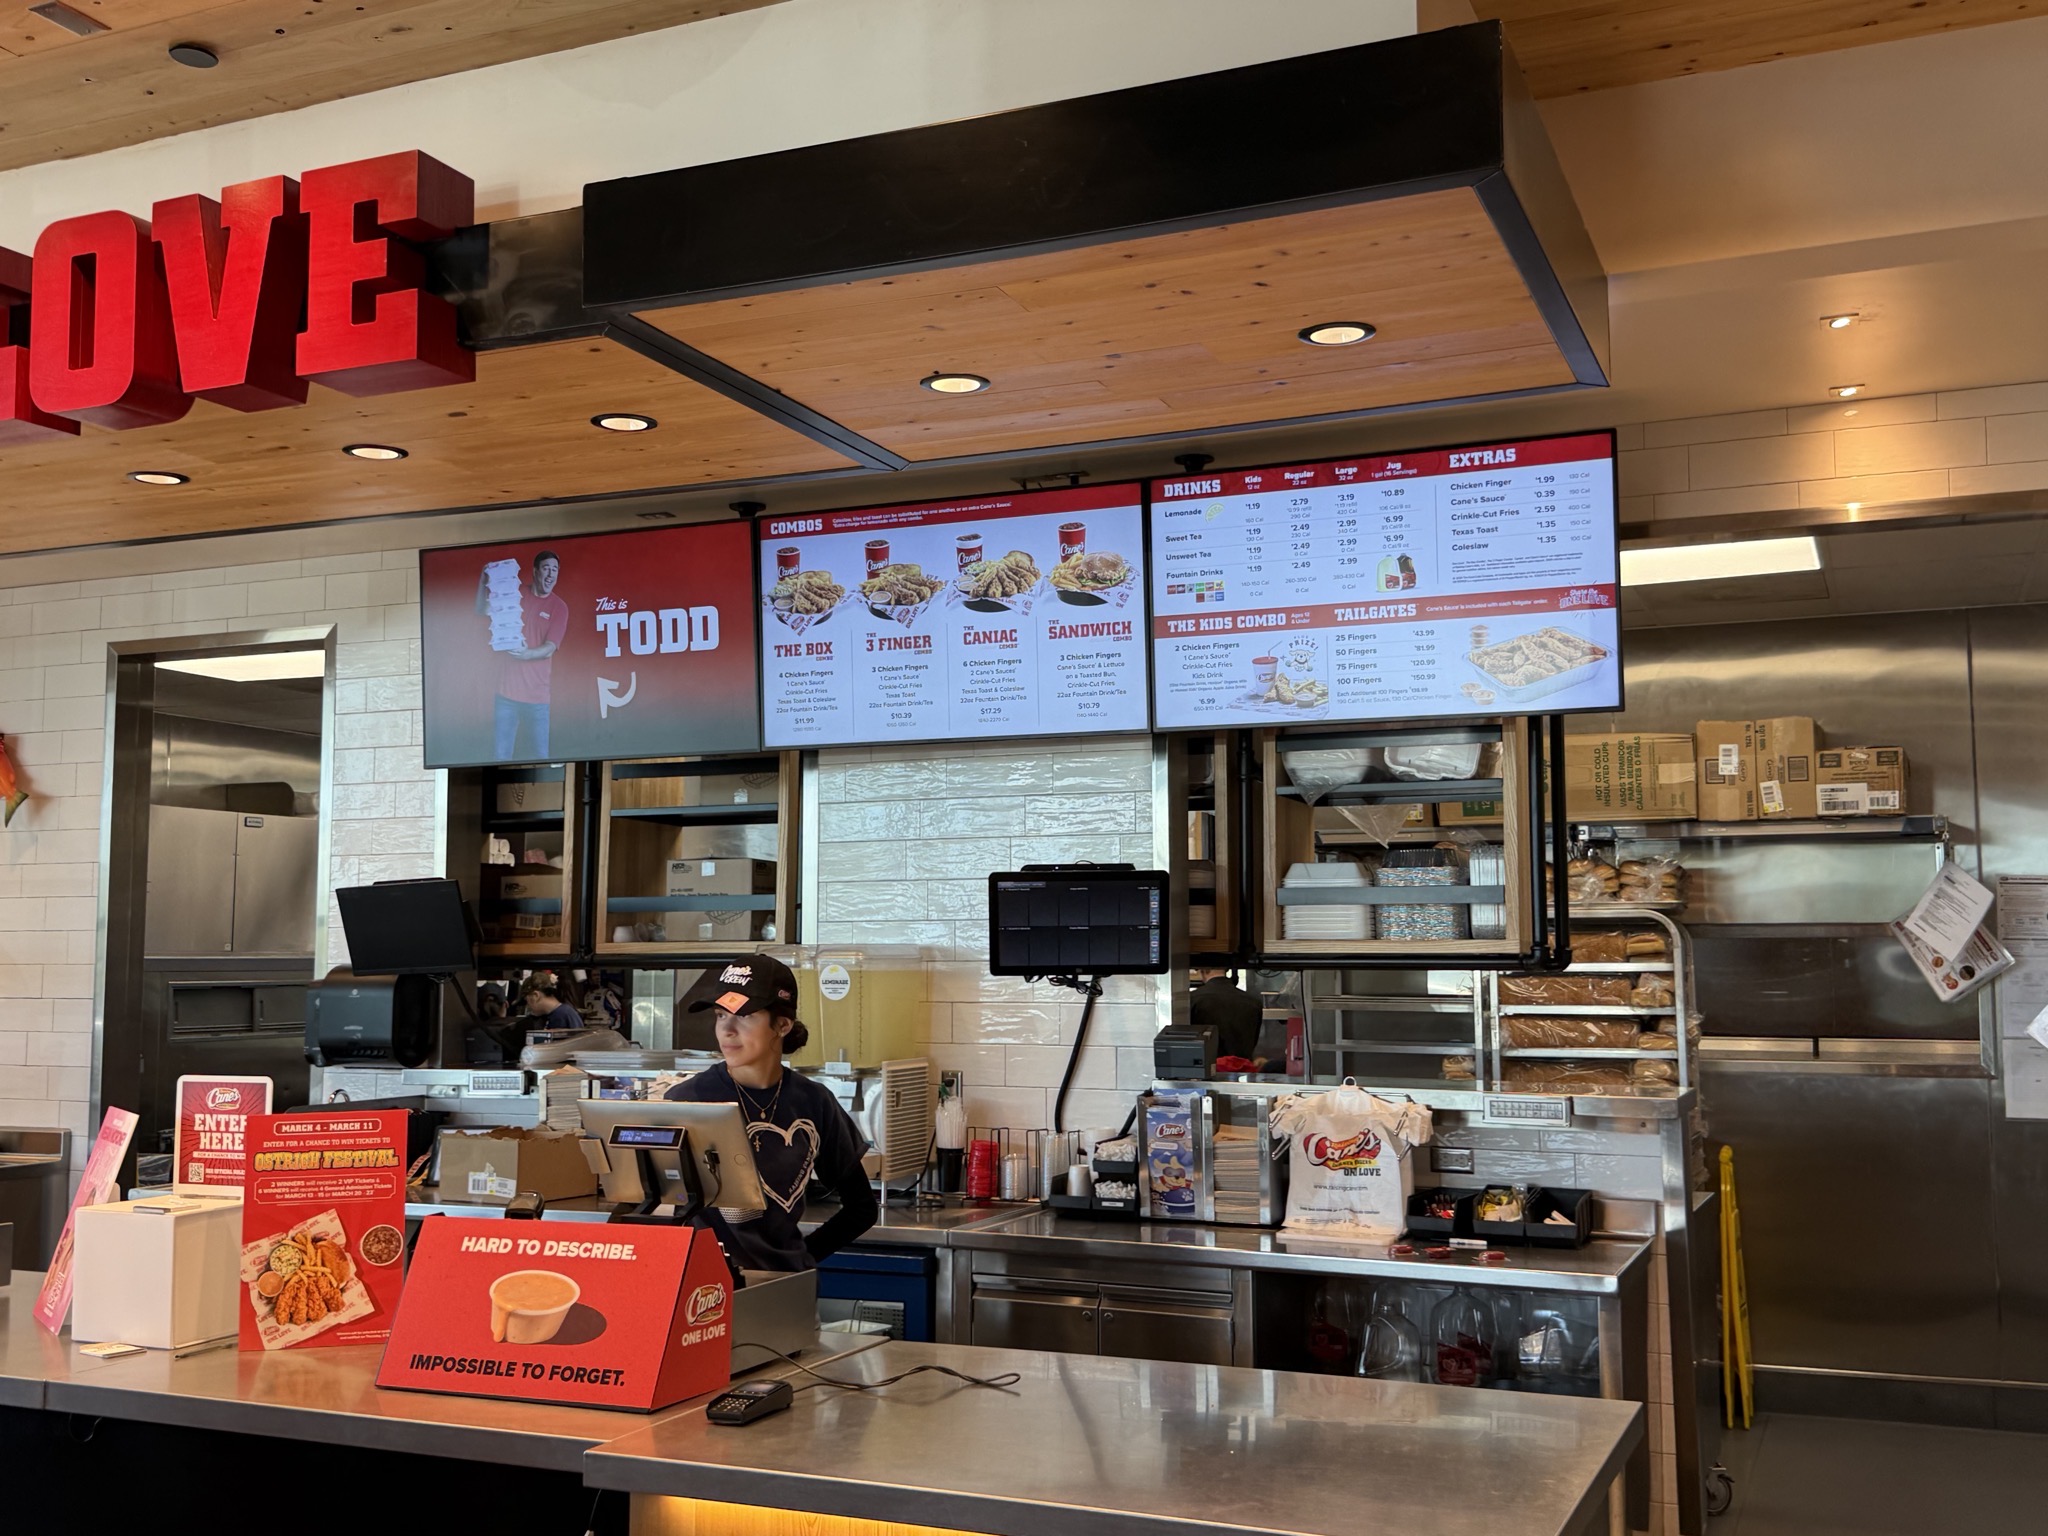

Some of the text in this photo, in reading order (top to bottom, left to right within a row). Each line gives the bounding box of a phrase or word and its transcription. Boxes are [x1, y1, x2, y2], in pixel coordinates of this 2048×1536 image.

[0, 150, 474, 437] OVE
[1449, 448, 1516, 468] EXTRAS
[1335, 466, 1358, 476] Large
[1386, 462, 1402, 470] Jug
[1245, 475, 1261, 484] Kids
[1284, 470, 1314, 481] Regular
[1164, 480, 1221, 497] DRINKS
[1450, 478, 1512, 491] Chicken Finger
[1451, 497, 1478, 505] Cane's
[1165, 509, 1202, 517] Lemonade
[1451, 508, 1519, 520] Crinkle-Cut Fries
[770, 519, 823, 534] COMBOS
[1166, 534, 1188, 543] Sweet
[1452, 542, 1489, 551] Coleslaw
[1166, 552, 1197, 561] Unsweet
[1167, 570, 1198, 579] Fountain
[596, 597, 628, 610] This is
[1334, 604, 1415, 622] TAILGATES
[1167, 614, 1286, 633] THE KIDS COMBO
[596, 606, 719, 657] TODD
[1049, 621, 1132, 640] SANDWICH
[866, 635, 931, 651] 3 FINGER
[963, 629, 1018, 645] CANIAC
[1348, 633, 1377, 641] Fingers
[774, 642, 833, 658] THE BOX
[1181, 643, 1210, 651] Chicken
[1213, 642, 1240, 650] Fingers
[1349, 648, 1377, 656] Fingers
[998, 658, 1022, 666] Fingers
[1067, 653, 1093, 661] Chicken
[1095, 652, 1121, 660] Fingers
[1349, 662, 1377, 670] Fingers
[810, 669, 833, 677] Fingers
[1353, 676, 1382, 685] Fingers
[981, 707, 1001, 715] $17.29
[1078, 702, 1100, 710] $10.79
[1595, 772, 1601, 782] OR
[1602, 765, 1610, 806] INSULATED
[1634, 768, 1643, 810] CALIENTES
[1619, 782, 1627, 807] VASOS
[209, 1088, 240, 1107] Cane's
[329, 1123, 360, 1131] MARCH
[1156, 1123, 1184, 1138] Cane's
[200, 1132, 244, 1150] HERE
[254, 1147, 400, 1172] OSTRICH FESTIVAL
[1359, 1168, 1381, 1176] LOVE
[461, 1236, 637, 1261] HARD TO DESCRIBE.
[686, 1283, 725, 1320] Cane's
[681, 1324, 726, 1346] ONE LOVE
[409, 1354, 626, 1387] IMPOSSIBLE TO FORGET.
